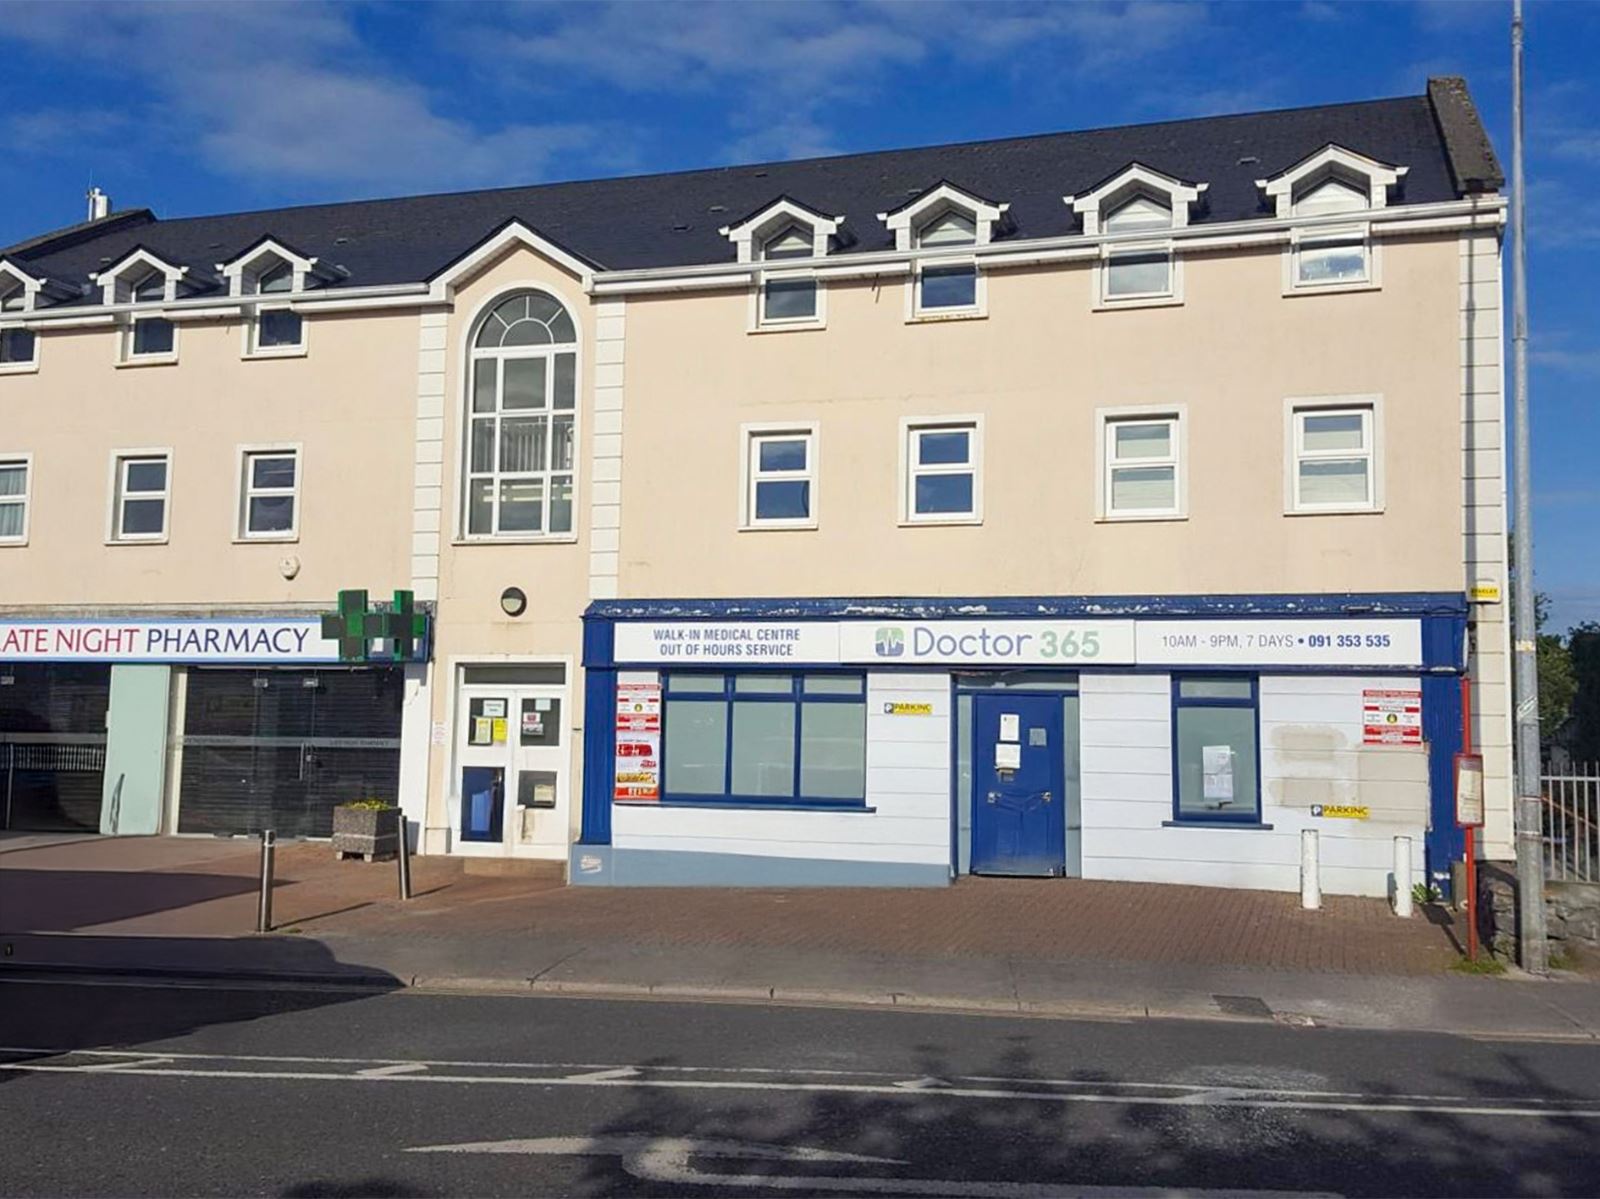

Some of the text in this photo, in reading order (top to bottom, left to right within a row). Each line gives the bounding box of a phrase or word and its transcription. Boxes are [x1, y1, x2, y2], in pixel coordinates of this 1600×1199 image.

[0, 627, 310, 653] ATE NIGHT PHARMACY
[653, 628, 799, 641] WALK-IN MEDICAL CENTRE
[660, 643, 793, 656] OUT OF HOURS SERVICE
[914, 628, 1100, 658] Doctor 365
[1163, 635, 1197, 648] 10AM
[1210, 635, 1242, 650] 9PM,
[1247, 635, 1254, 647] 7
[1258, 635, 1294, 648] DAYS
[1308, 635, 1332, 648] 091
[1336, 635, 1362, 648] 353
[1364, 635, 1391, 648] 535
